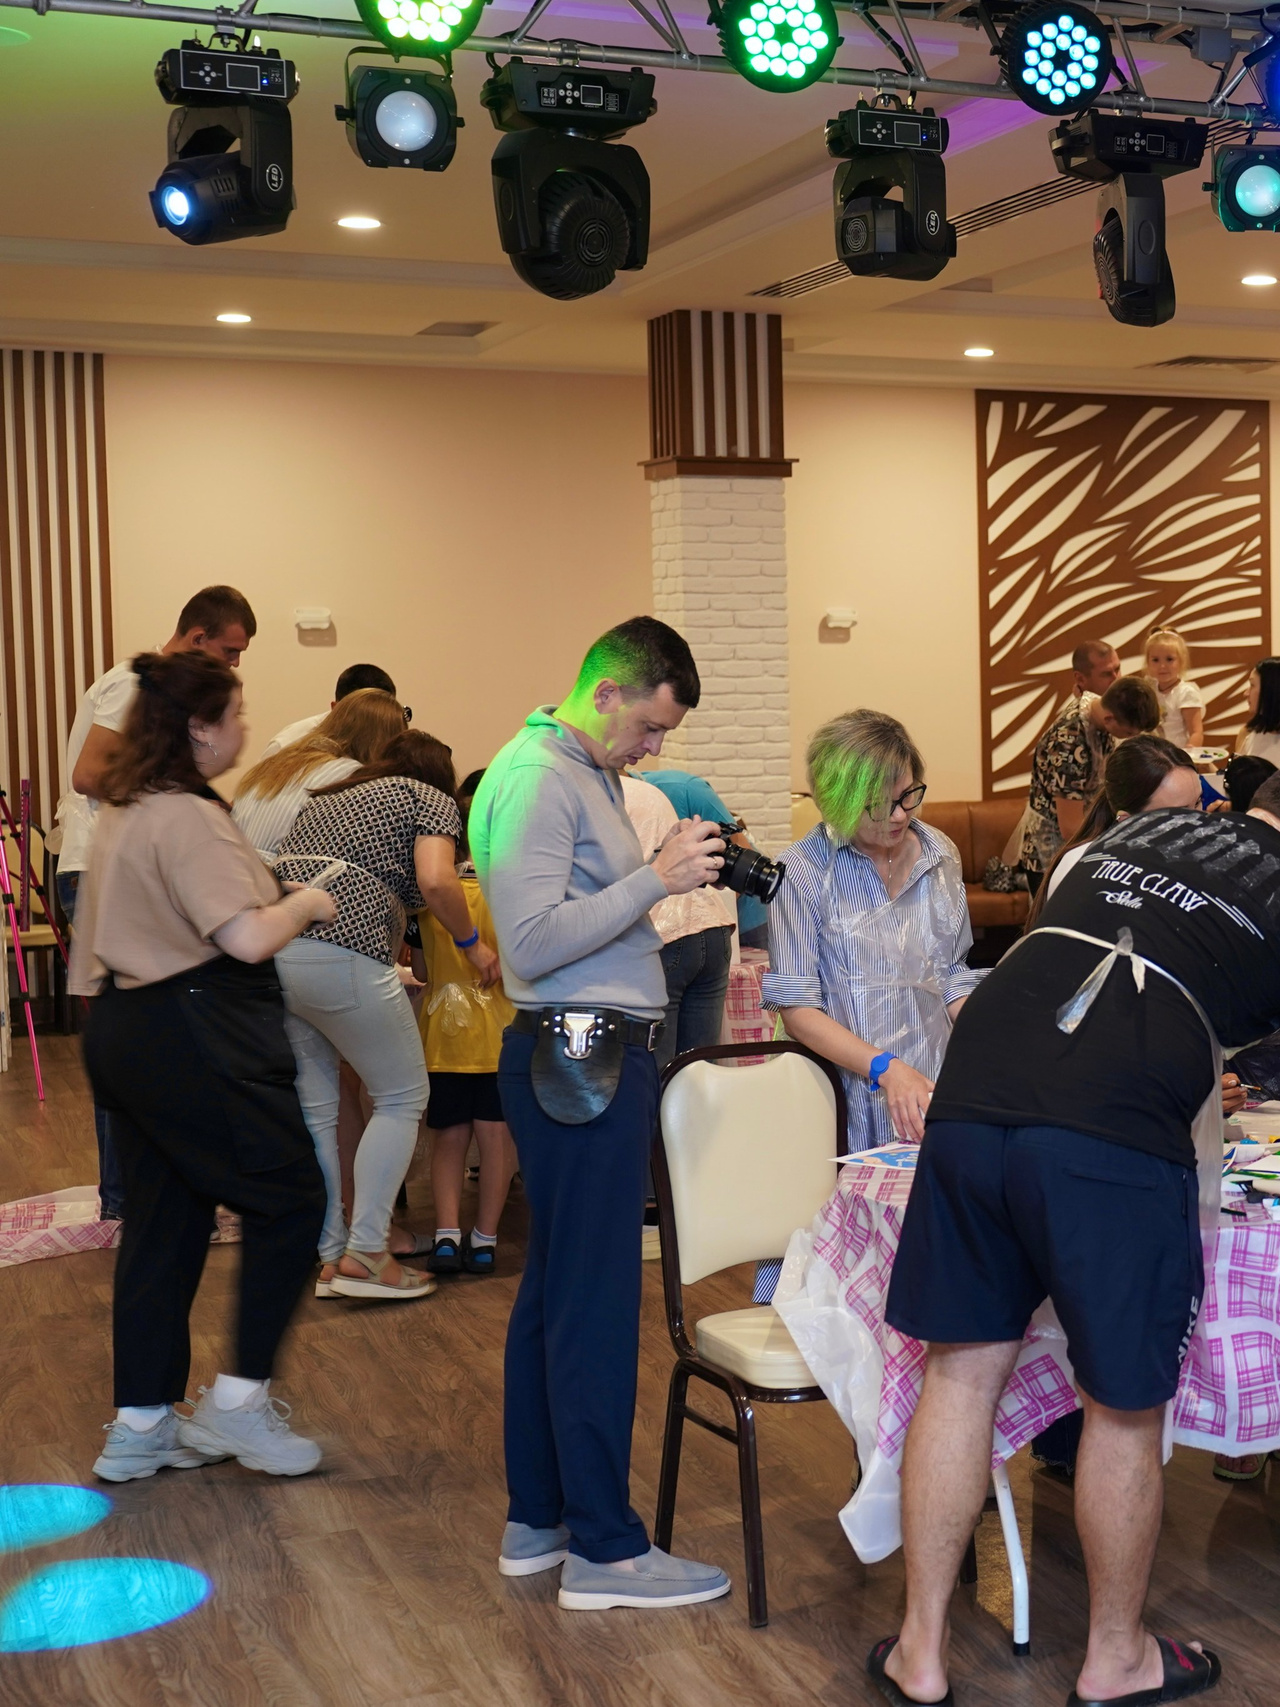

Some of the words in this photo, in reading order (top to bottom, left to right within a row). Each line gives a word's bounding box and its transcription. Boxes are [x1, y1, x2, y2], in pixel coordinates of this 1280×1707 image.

[271, 167, 279, 188] LED
[1091, 861, 1144, 886] TRUE
[1140, 873, 1208, 912] CLAW
